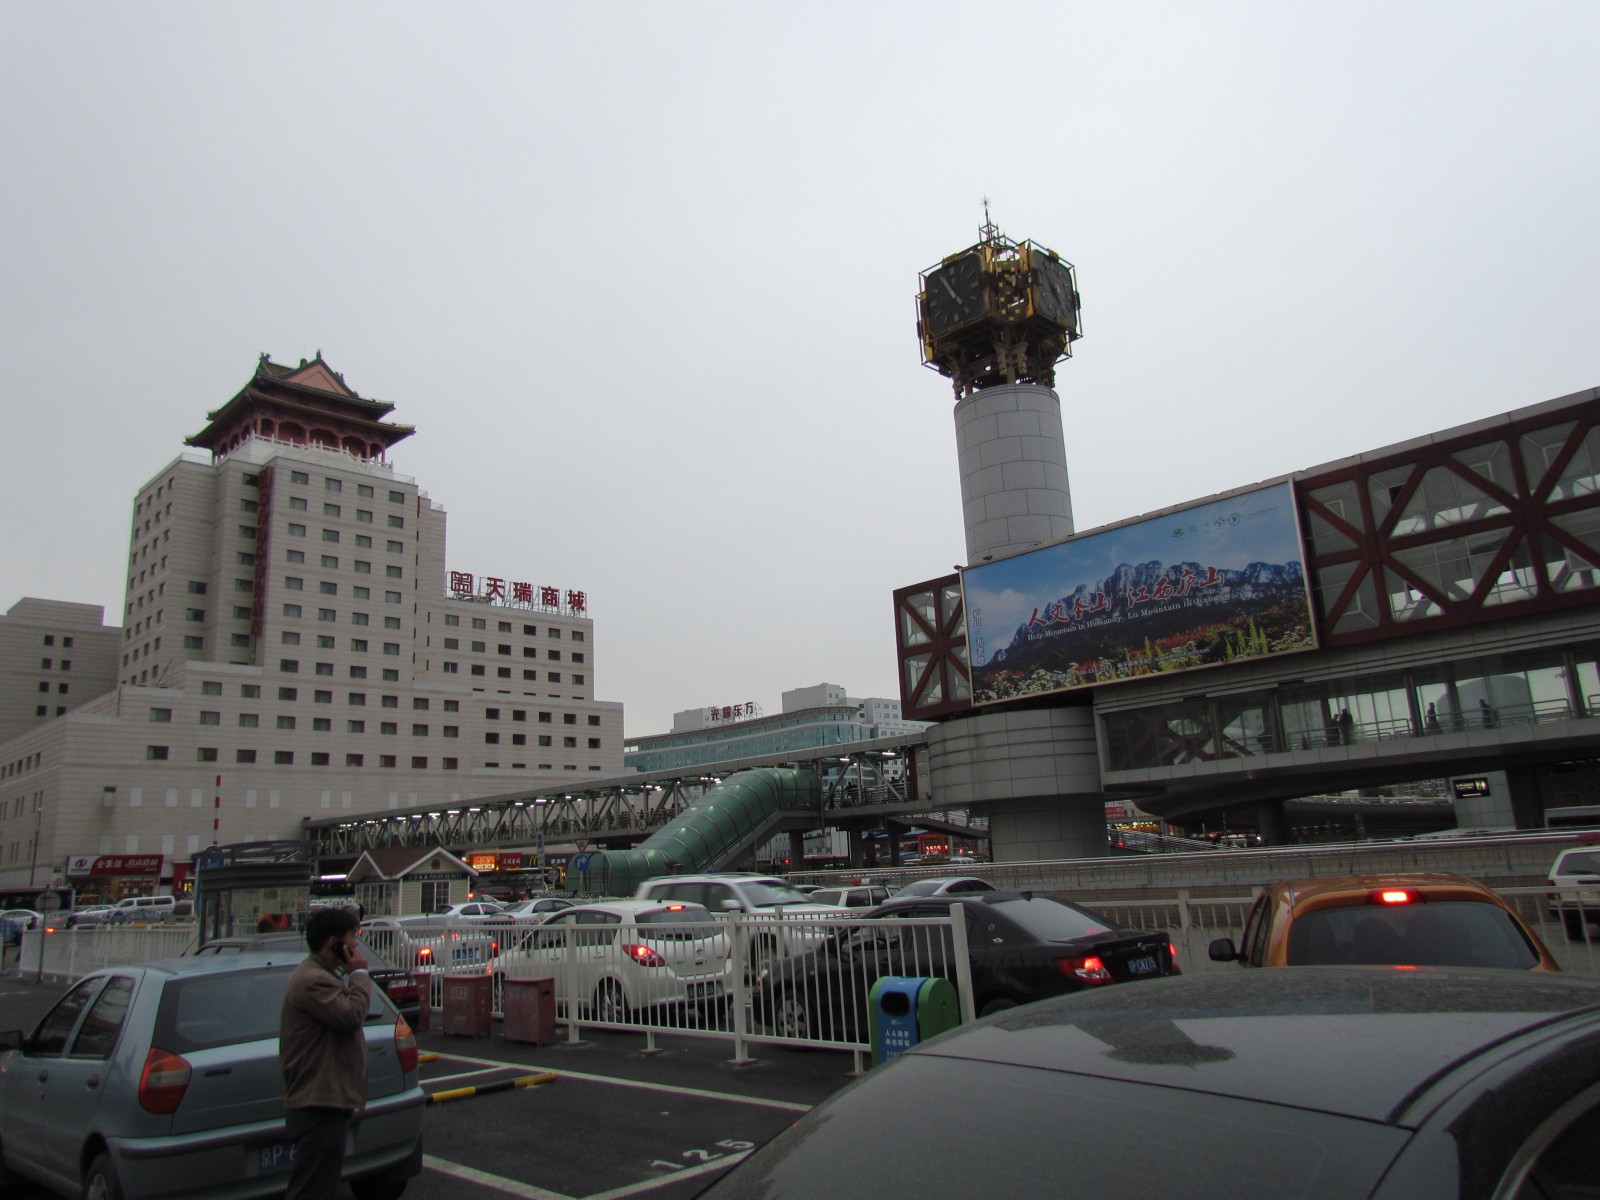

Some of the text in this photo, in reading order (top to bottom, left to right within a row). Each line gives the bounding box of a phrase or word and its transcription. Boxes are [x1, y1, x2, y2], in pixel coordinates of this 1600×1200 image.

[486, 576, 586, 611] 天瑞商城
[1044, 625, 1077, 637] Mountain
[1078, 623, 1086, 631] in
[1140, 603, 1181, 617] Mountain
[650, 1138, 755, 1168] 125
